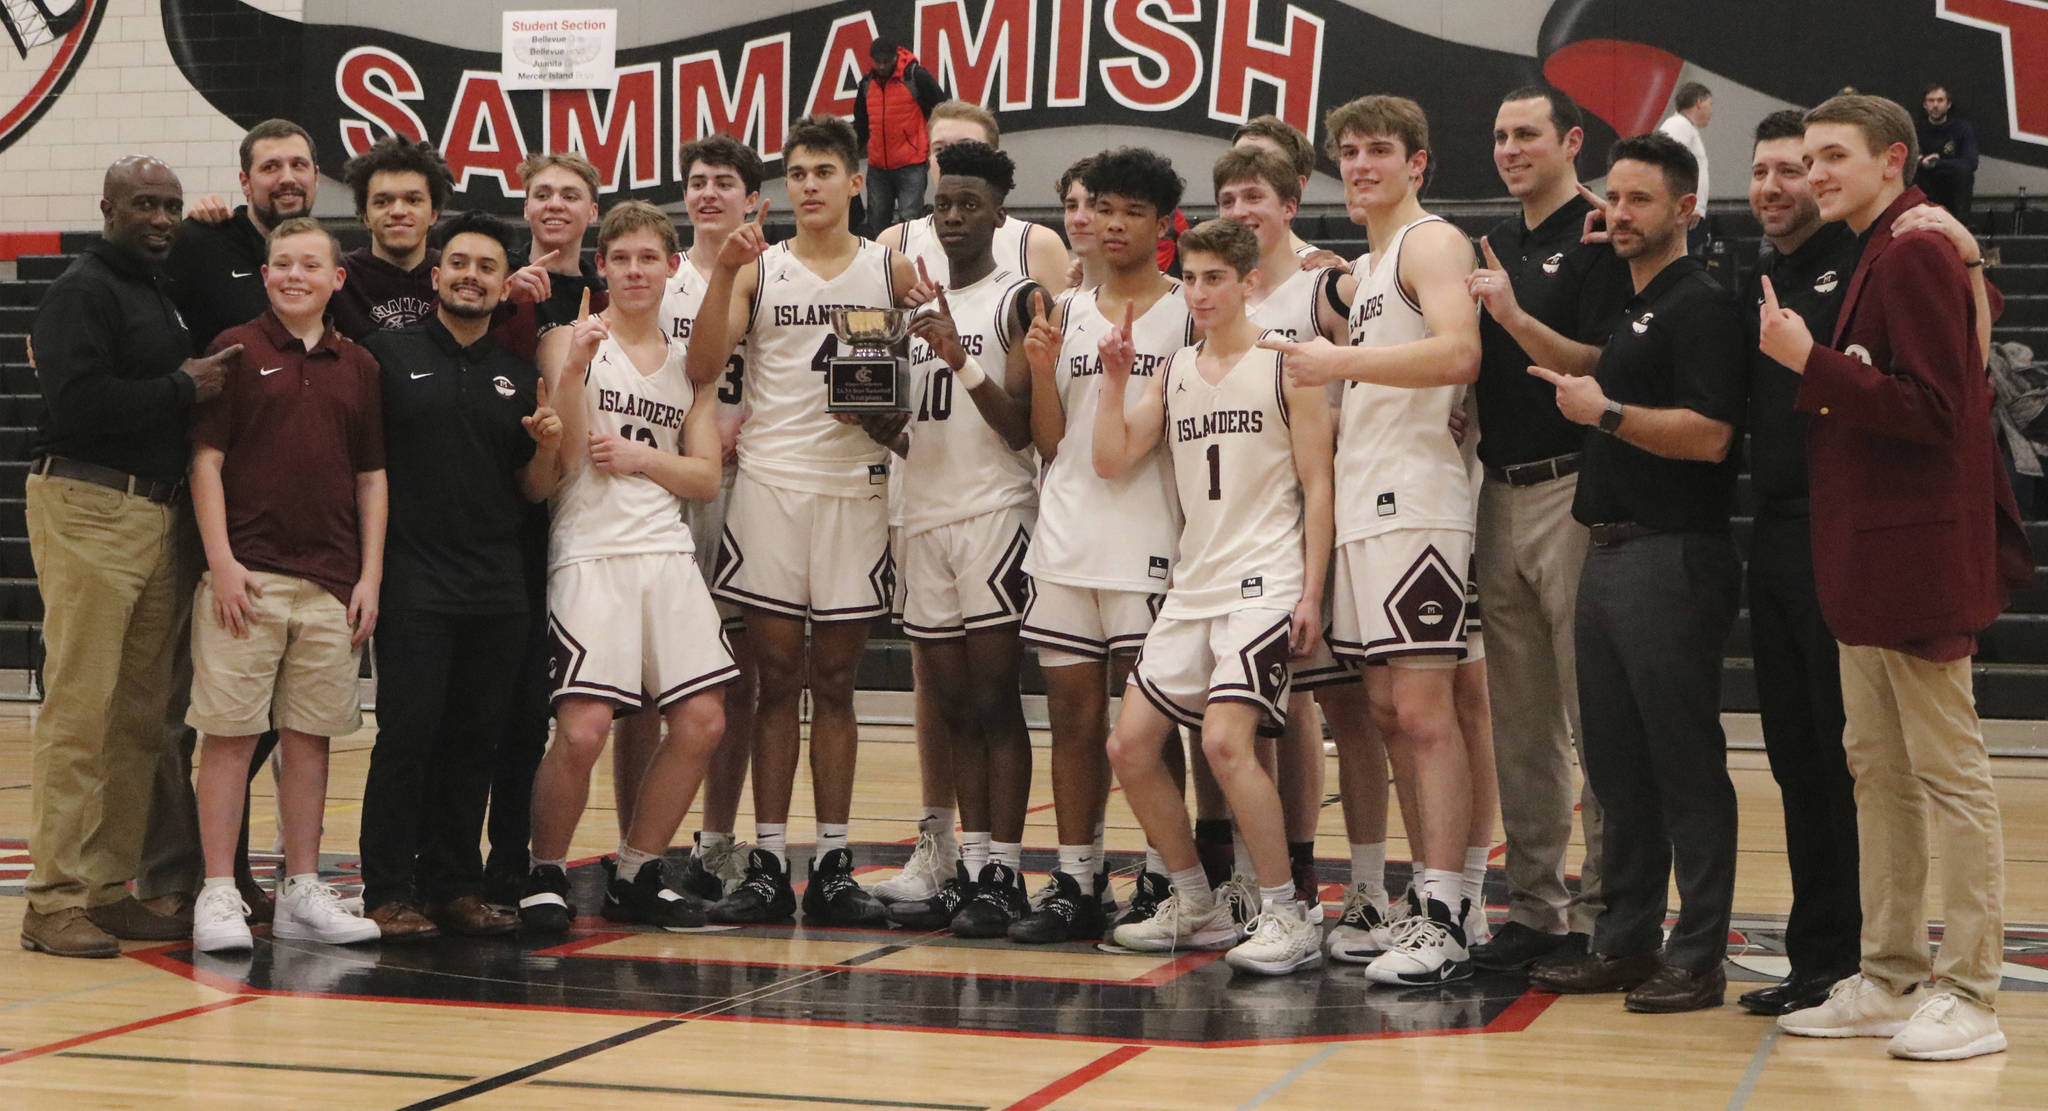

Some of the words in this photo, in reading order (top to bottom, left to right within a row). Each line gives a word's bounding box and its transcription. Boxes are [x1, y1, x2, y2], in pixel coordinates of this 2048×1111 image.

[512, 20, 558, 32] Student
[561, 19, 606, 31] Section
[531, 35, 567, 43] Bellevue
[529, 47, 565, 56] Bellevue
[532, 60, 562, 68] Juanita
[518, 72, 546, 80] Mercer
[548, 71, 574, 80] Island
[335, 0, 1327, 199] SAMMAMISH
[917, 367, 953, 421] 10
[1177, 410, 1263, 442] ISLANDERS
[1206, 444, 1221, 500] 1
